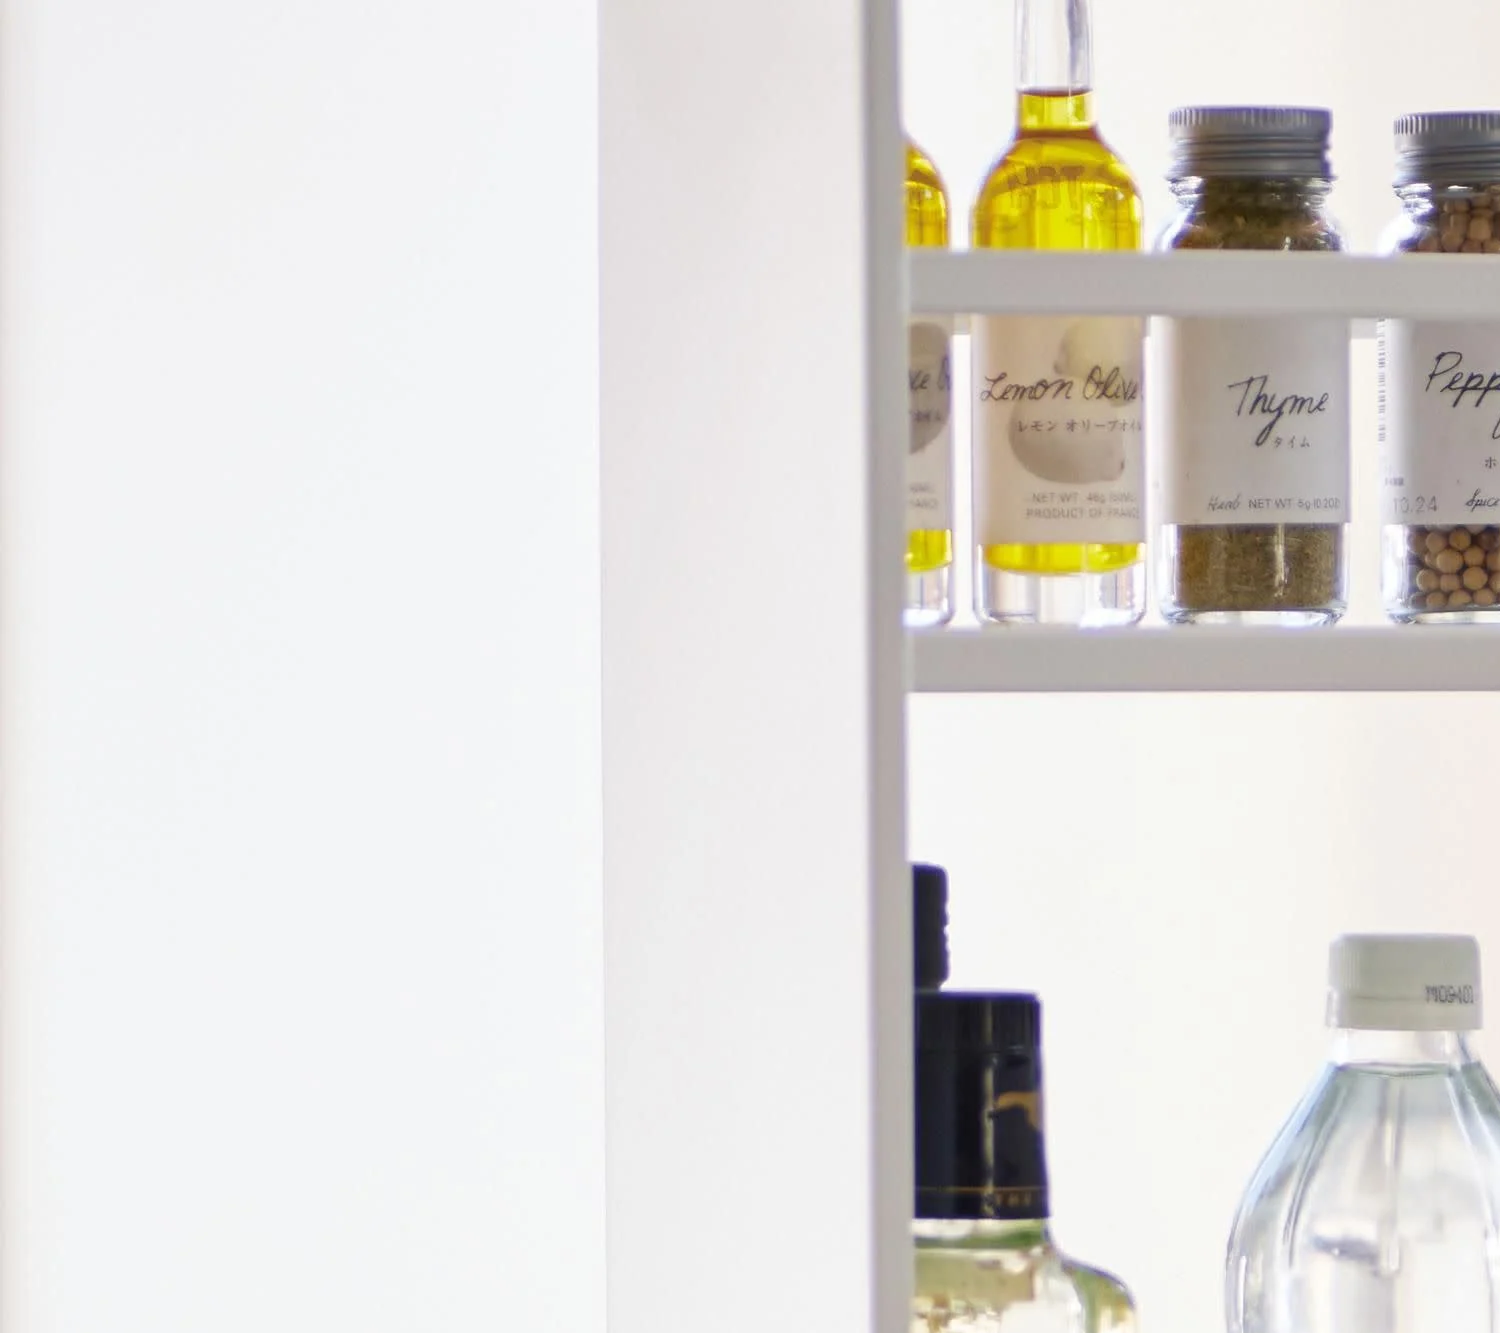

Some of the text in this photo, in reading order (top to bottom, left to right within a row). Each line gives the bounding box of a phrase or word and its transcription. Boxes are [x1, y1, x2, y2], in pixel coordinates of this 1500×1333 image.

[980, 371, 1074, 402] Lemon
[1227, 374, 1330, 447] Thyme
[1248, 499, 1271, 509] NET
